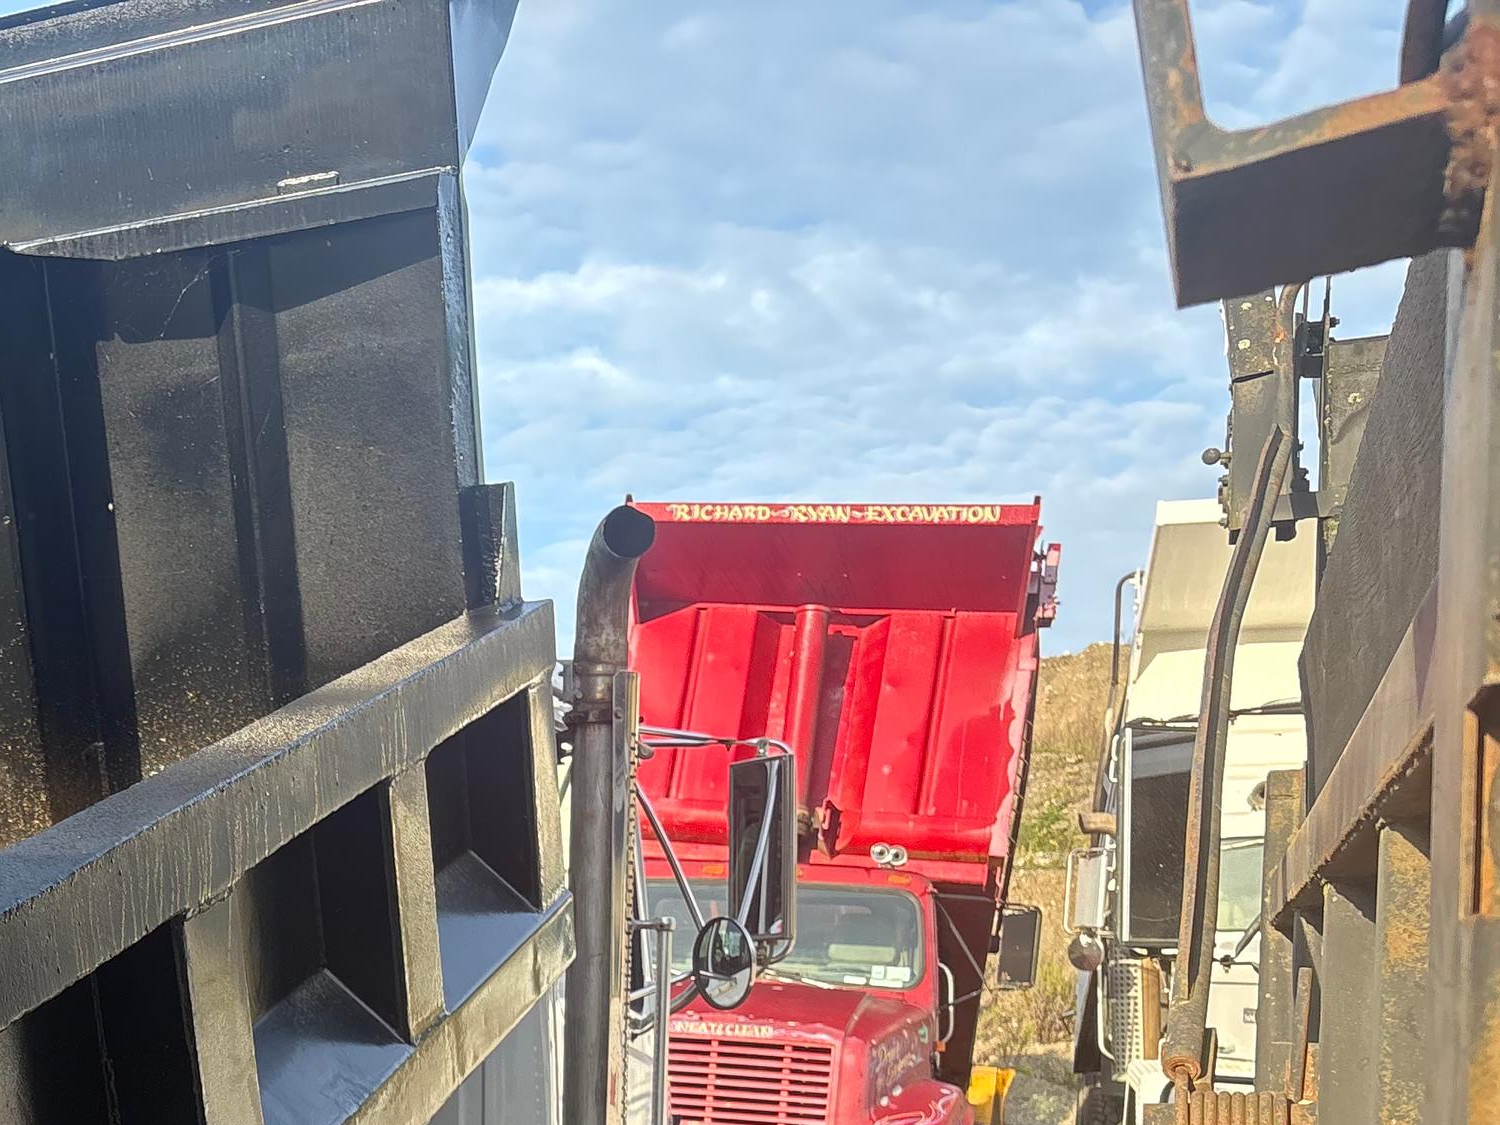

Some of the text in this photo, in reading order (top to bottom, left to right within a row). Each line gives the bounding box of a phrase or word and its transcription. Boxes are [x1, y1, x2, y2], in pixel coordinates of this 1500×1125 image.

[666, 504, 1001, 523] RICHARD RYAN EXCAVATION
